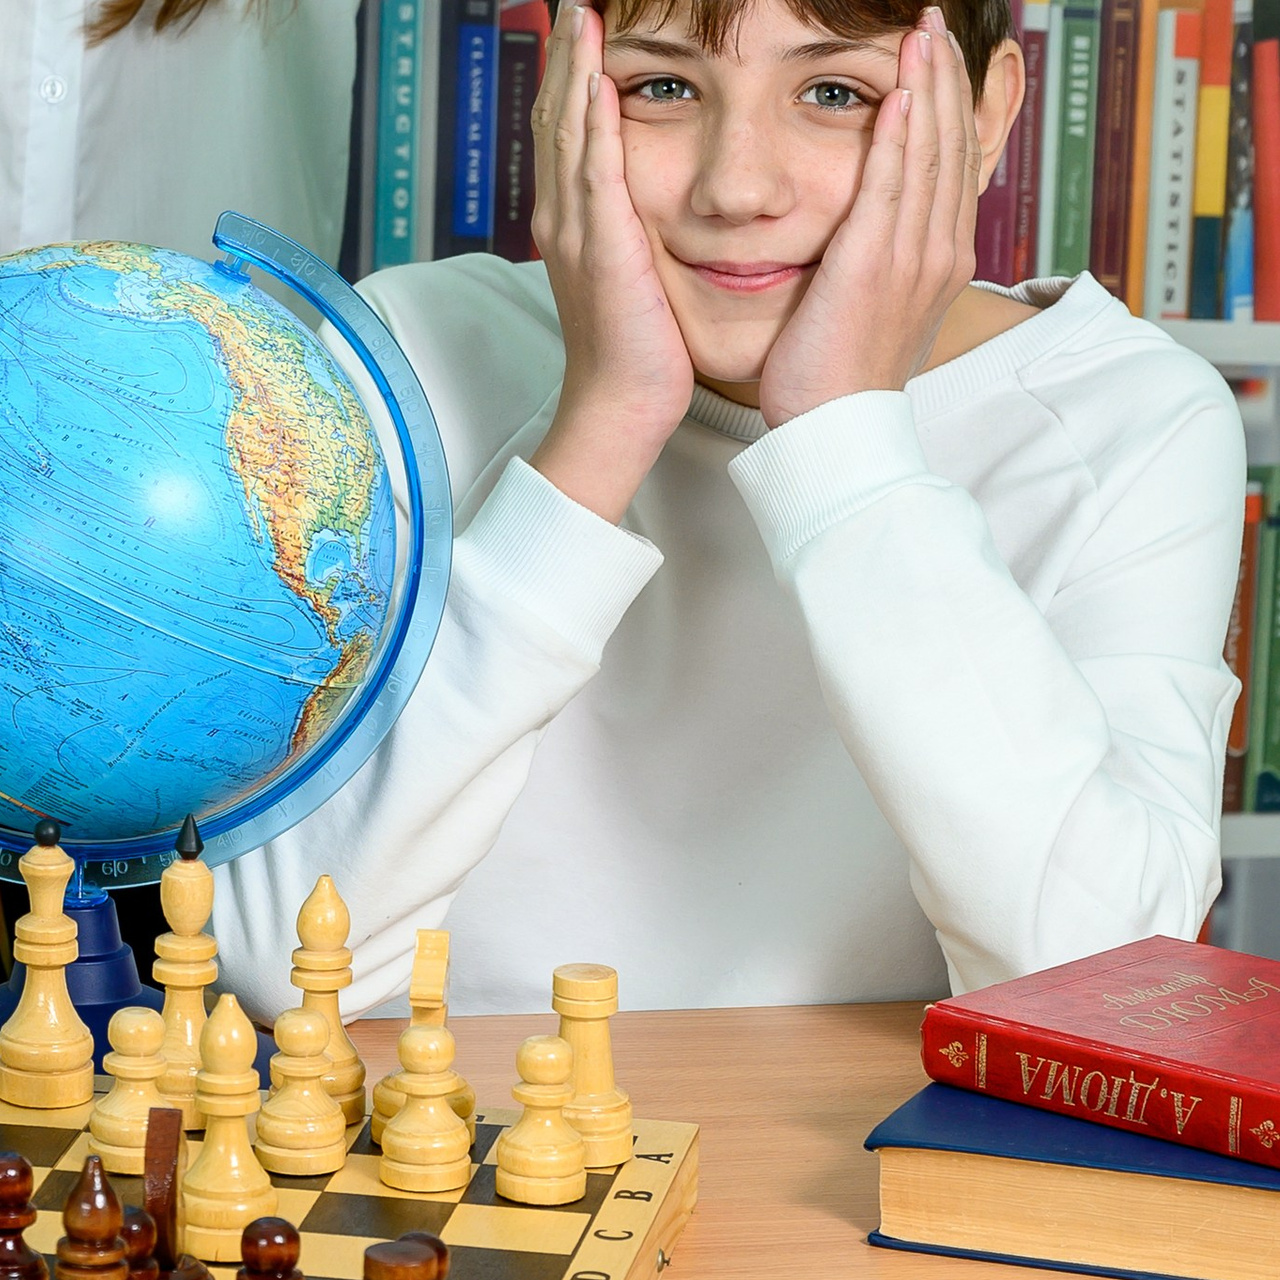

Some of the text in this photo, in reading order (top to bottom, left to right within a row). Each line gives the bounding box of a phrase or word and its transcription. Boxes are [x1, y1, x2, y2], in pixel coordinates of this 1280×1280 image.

[1066, 34, 1092, 139] HISTORY
[463, 35, 487, 226] CLASSICAL POETRY
[505, 61, 526, 222] Linear Algebra
[1162, 67, 1187, 306] STATISTICS
[289, 252, 317, 277] 80
[101, 859, 129, 877] 60
[1119, 976, 1280, 1031] ДЮМА
[634, 1151, 674, 1165] A
[613, 1188, 654, 1203] B
[593, 1228, 634, 1241] C
